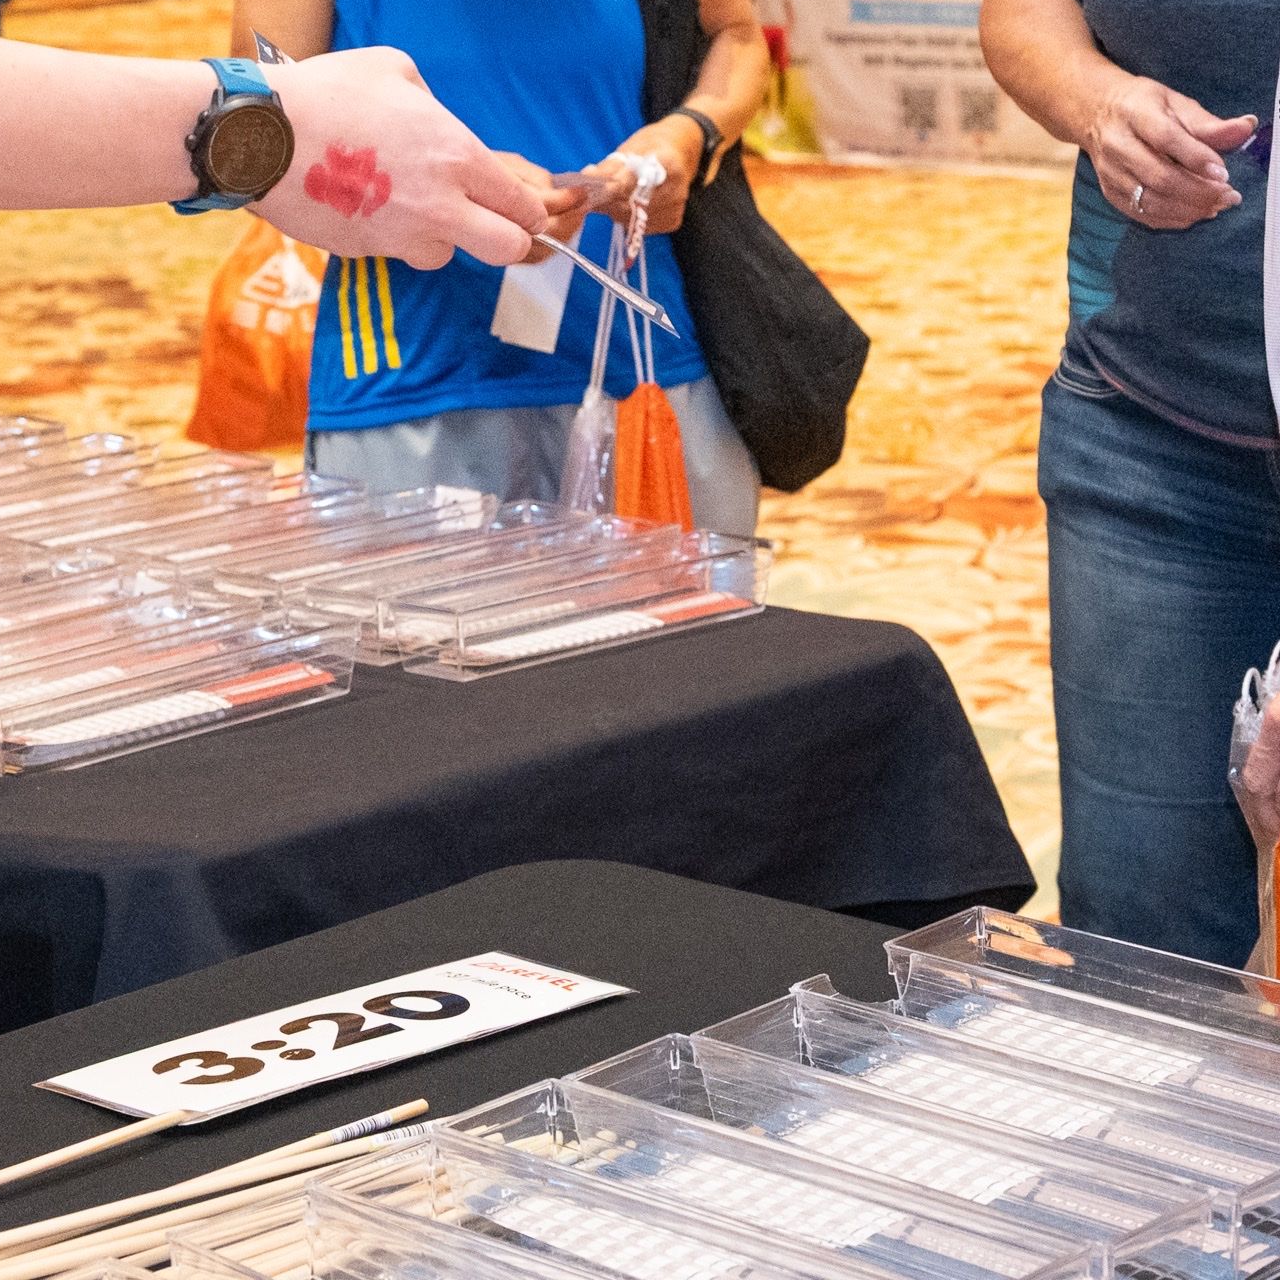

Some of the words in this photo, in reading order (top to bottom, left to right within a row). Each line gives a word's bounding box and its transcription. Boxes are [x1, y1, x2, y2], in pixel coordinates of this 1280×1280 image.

[506, 968, 580, 991] REVEL
[495, 985, 532, 999] pace
[152, 990, 470, 1085] 3:20
